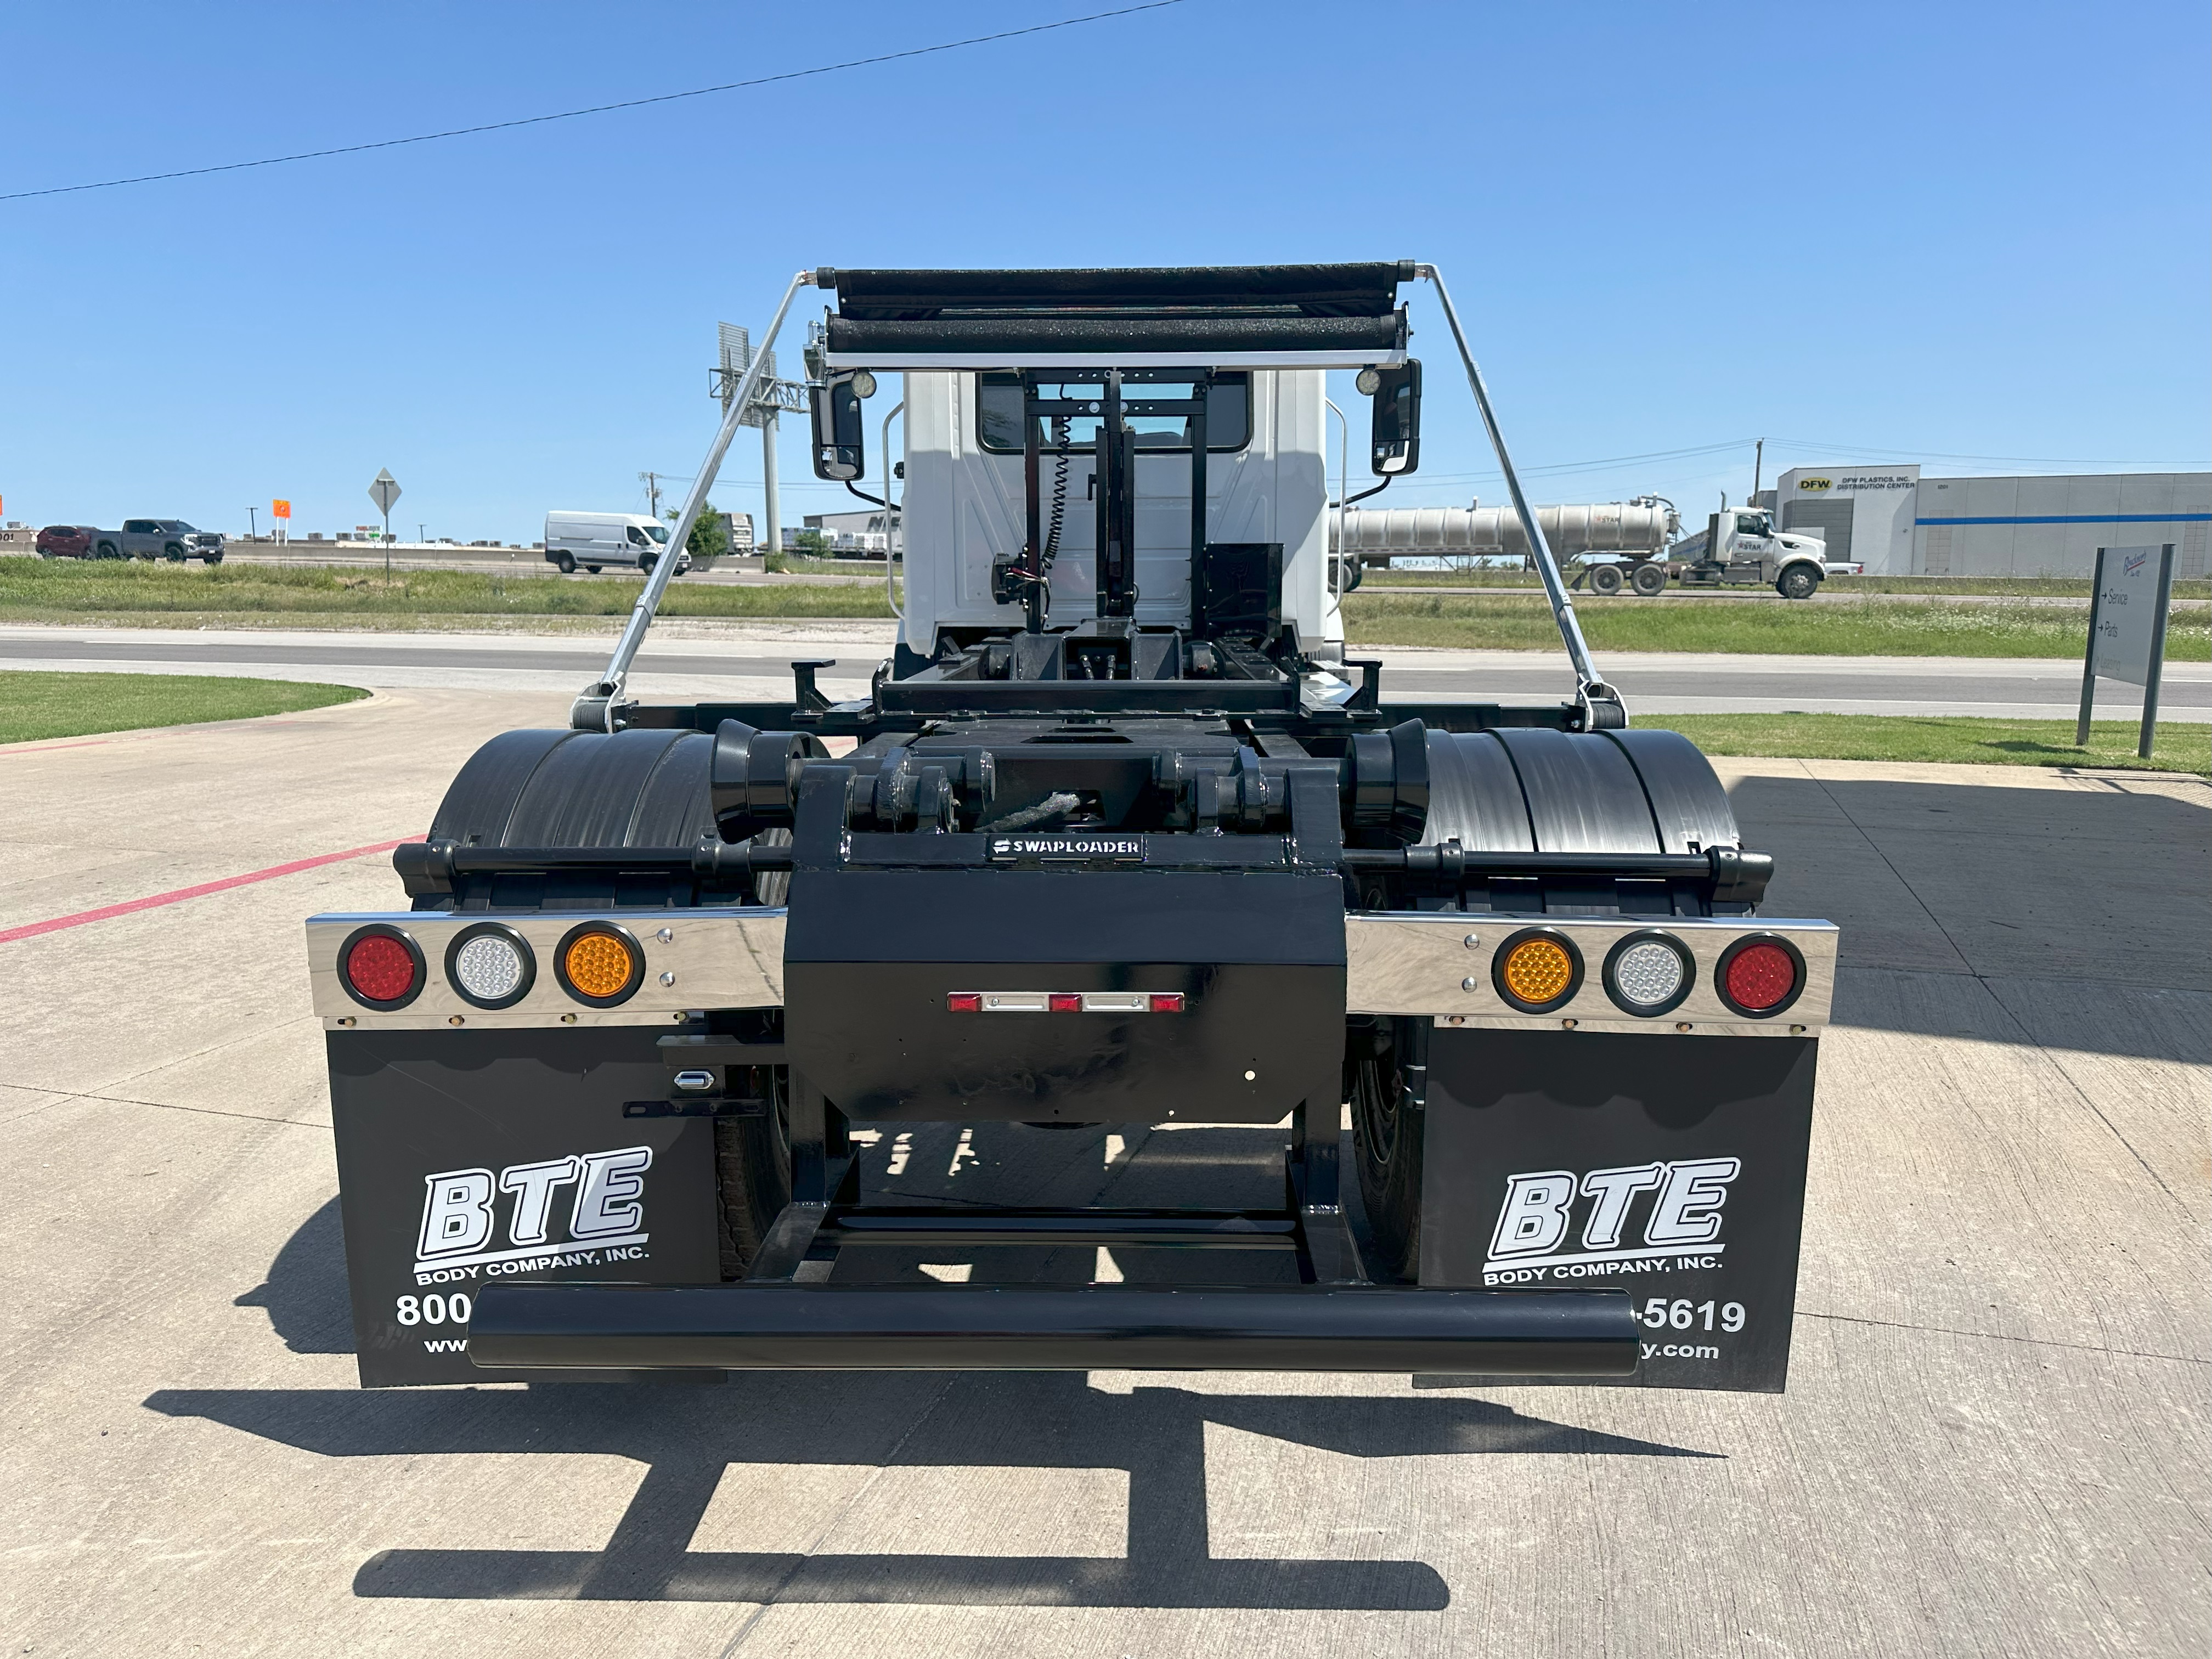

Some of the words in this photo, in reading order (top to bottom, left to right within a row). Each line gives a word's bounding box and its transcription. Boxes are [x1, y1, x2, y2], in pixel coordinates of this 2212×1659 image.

[2108, 588, 2128, 605] Service
[2104, 621, 2118, 637] Parts
[1013, 840, 1139, 853] SWAPLOADER
[416, 1146, 653, 1261] BTE
[1487, 1156, 1741, 1261] BTE
[416, 1265, 480, 1286] BODY
[486, 1251, 600, 1277] COMPANY,
[605, 1246, 650, 1262] INC.
[1483, 1267, 1549, 1286] BODY
[1554, 1258, 1671, 1279] COMPANY,
[1677, 1256, 1723, 1269] INC.
